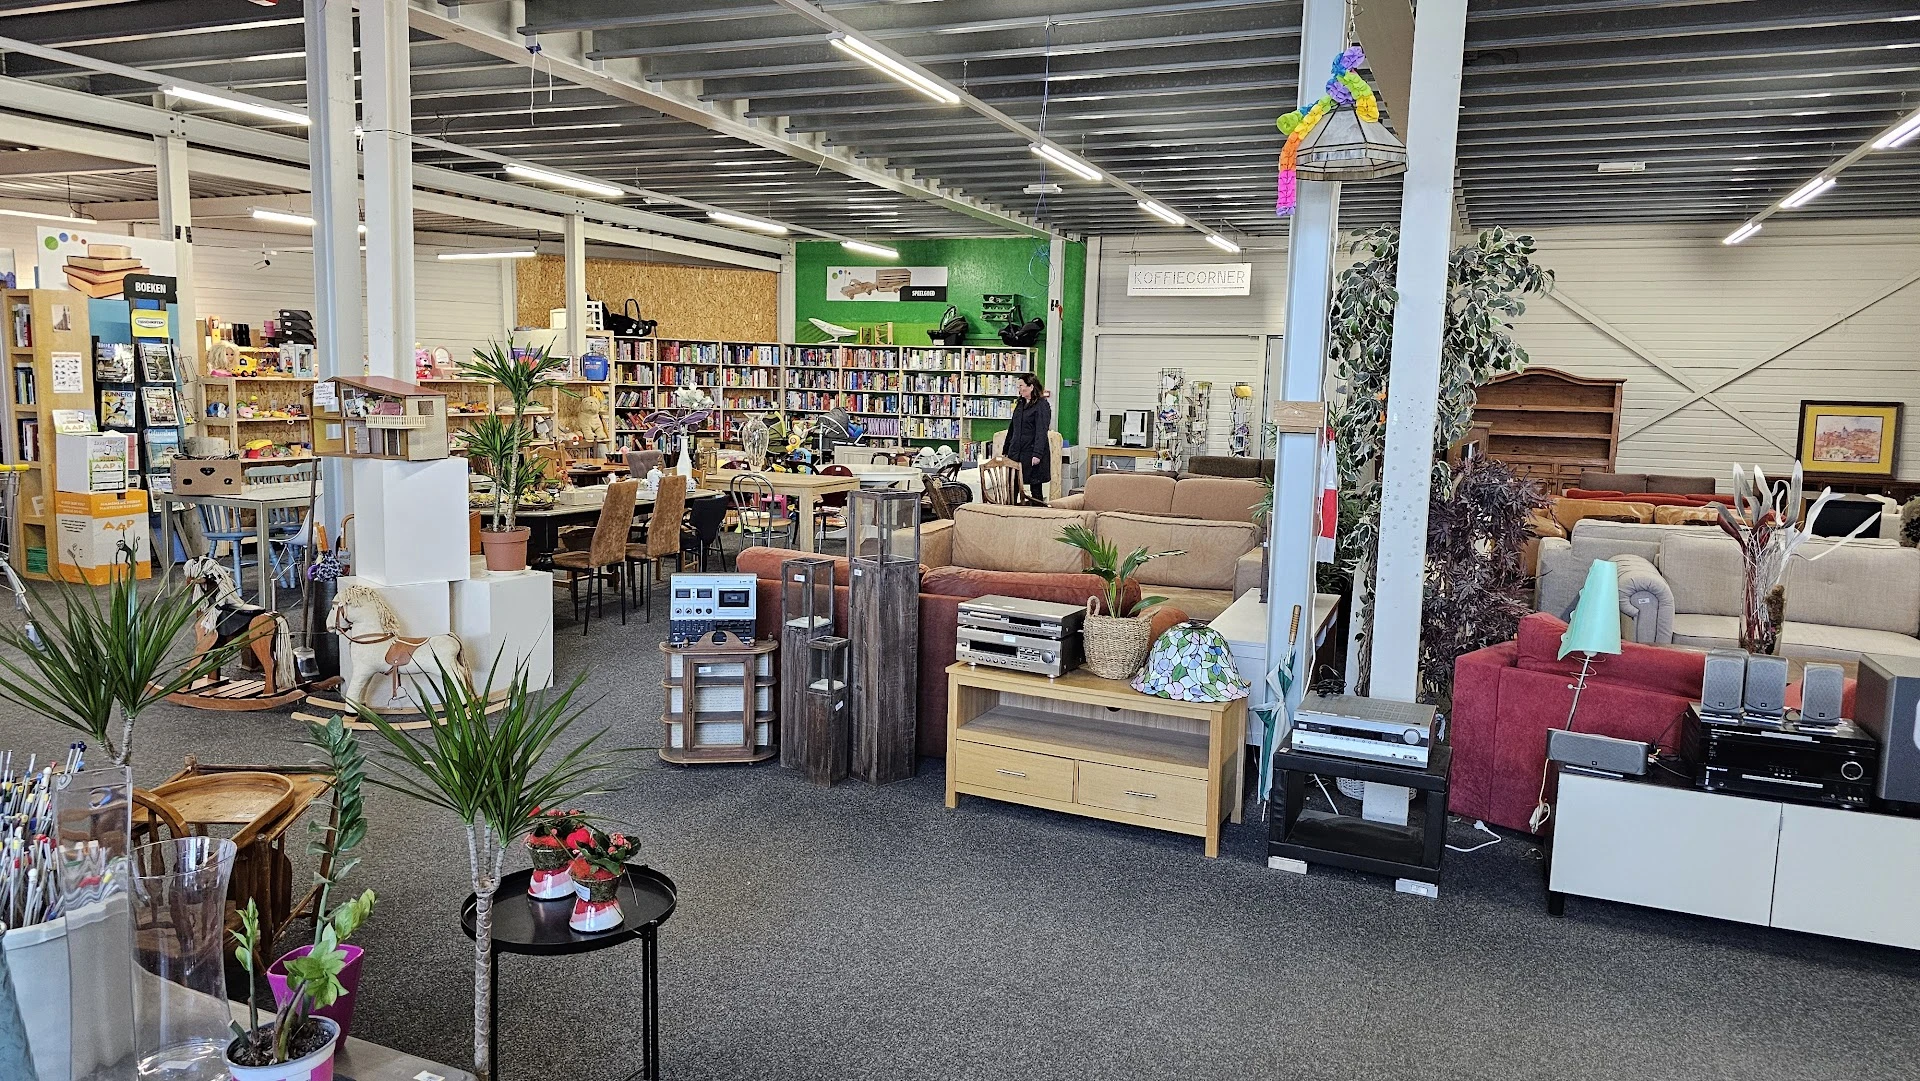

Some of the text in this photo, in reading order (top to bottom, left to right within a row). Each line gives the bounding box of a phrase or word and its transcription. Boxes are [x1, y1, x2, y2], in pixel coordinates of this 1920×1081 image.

[1134, 270, 1245, 284] KOFFIECORNER
[135, 281, 167, 294] BOEKEN
[103, 519, 135, 531] AAP
